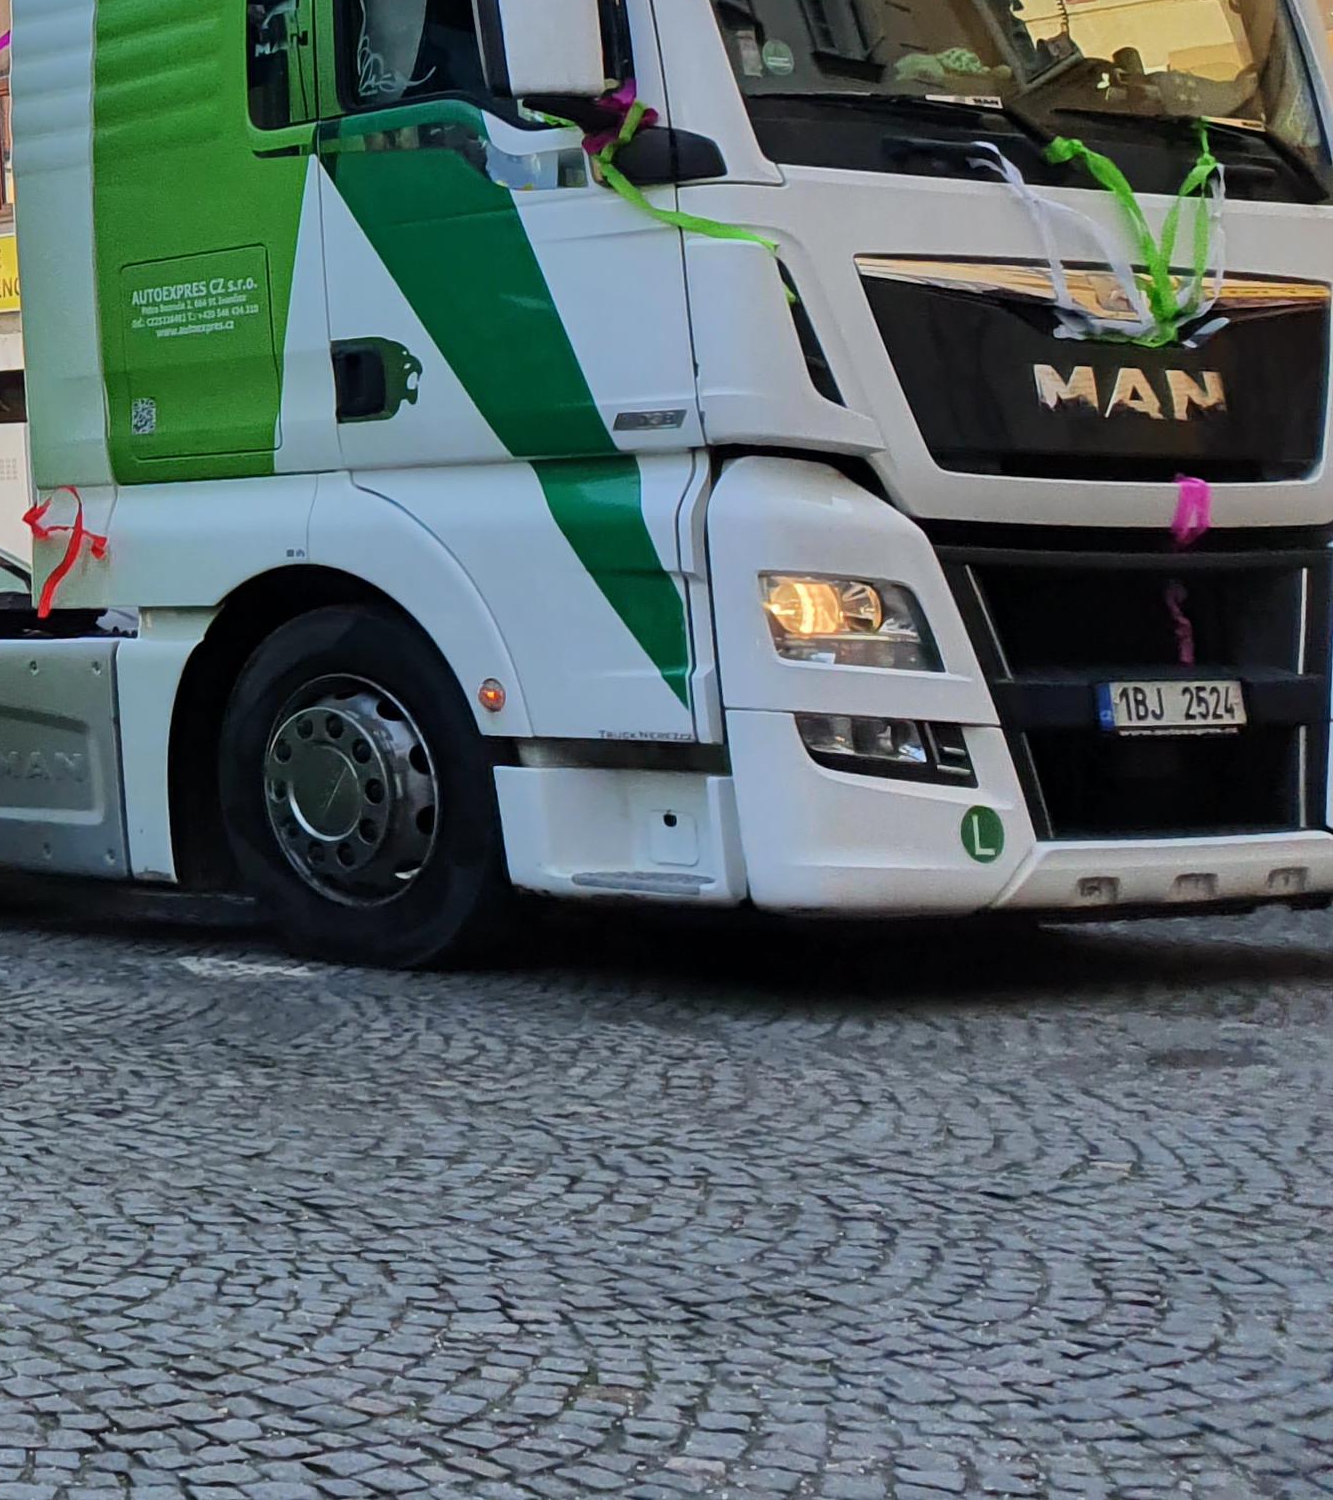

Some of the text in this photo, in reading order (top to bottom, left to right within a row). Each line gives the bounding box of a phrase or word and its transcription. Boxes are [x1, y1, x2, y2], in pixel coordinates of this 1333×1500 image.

[132, 281, 207, 305] AUTOEXPRES
[209, 278, 225, 295] CZ
[1034, 363, 1228, 420] MAN
[1119, 686, 1236, 721] 1BJ 2524
[972, 815, 995, 855] L
